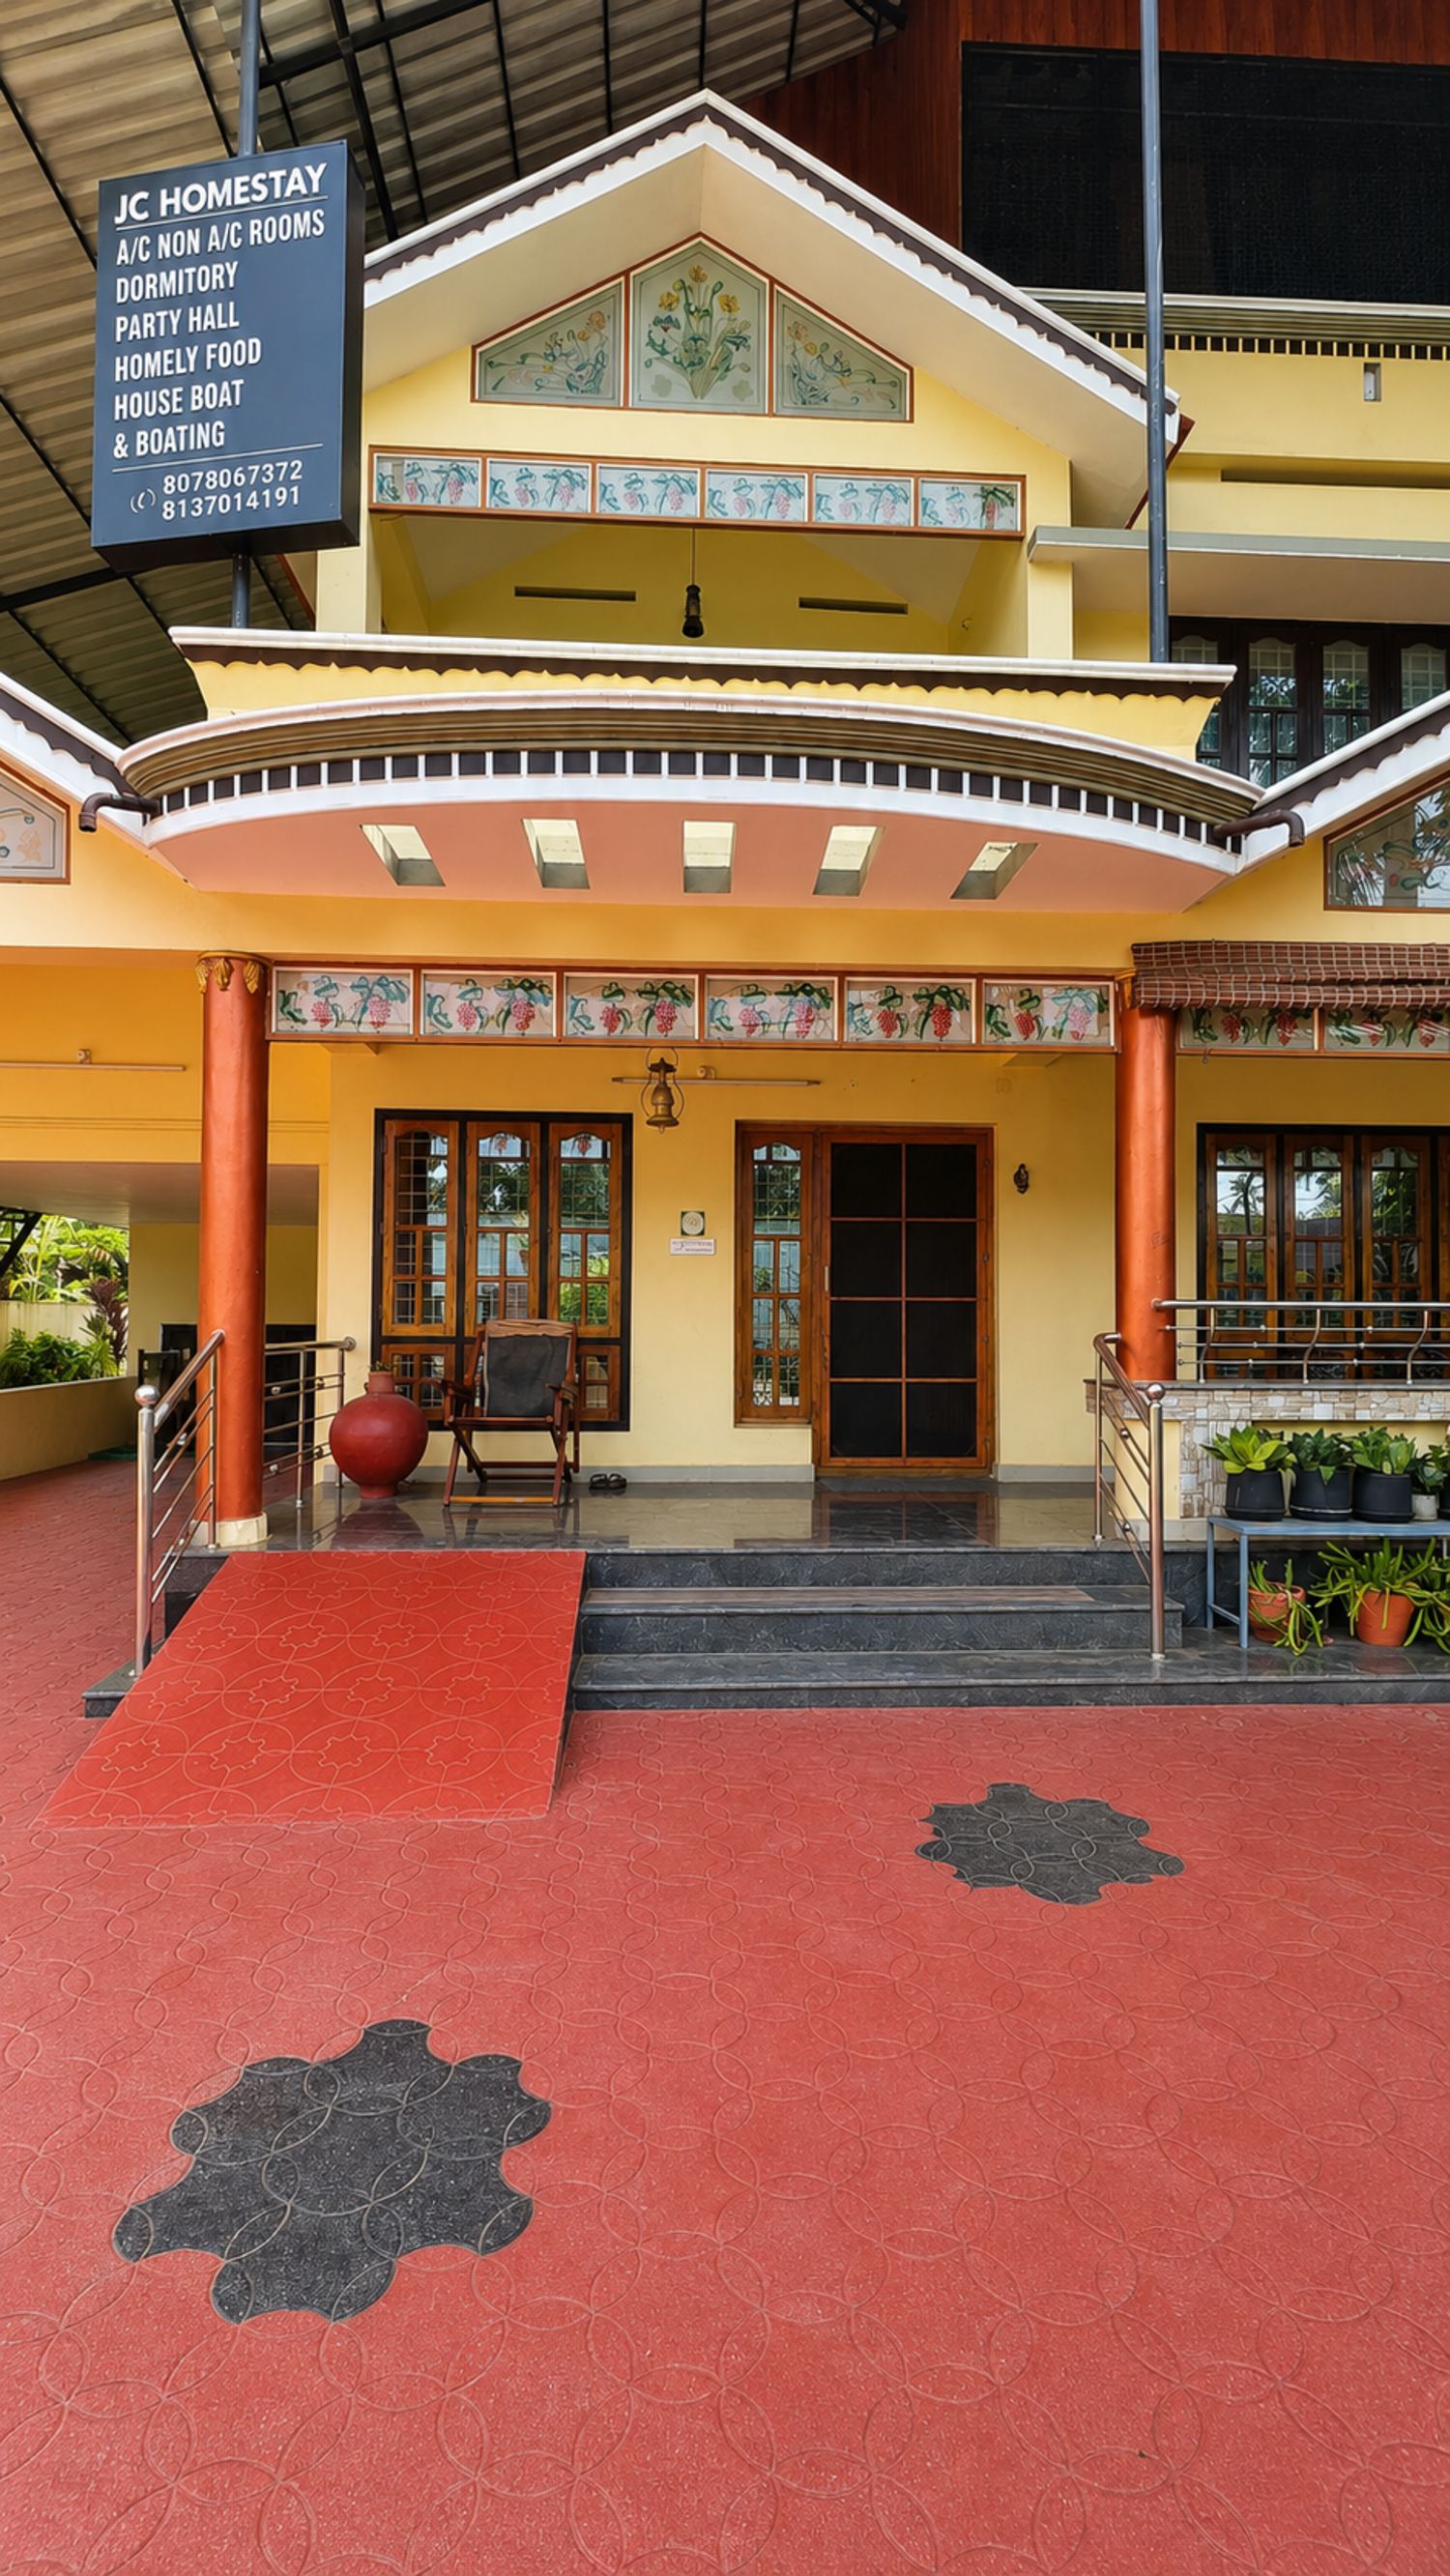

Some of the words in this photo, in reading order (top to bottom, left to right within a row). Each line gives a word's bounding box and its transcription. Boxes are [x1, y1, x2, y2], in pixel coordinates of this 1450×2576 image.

[114, 191, 150, 224] JC
[160, 162, 327, 217] HOMESTAY
[116, 235, 151, 266] A/C
[158, 227, 201, 260] NON
[207, 221, 243, 253] A/C
[249, 209, 325, 246] ROOMS
[116, 261, 239, 304] DORMITORY
[115, 308, 183, 342] PARTY
[188, 302, 240, 333] HALL
[114, 345, 199, 383] HOMELY
[206, 338, 262, 370] FOOD
[114, 387, 184, 420] HOUSE
[190, 379, 245, 411] BOAT
[112, 433, 129, 459] &
[135, 420, 225, 457] BOATING
[163, 460, 303, 495] 8078067372
[161, 485, 299, 520] 8137014191
